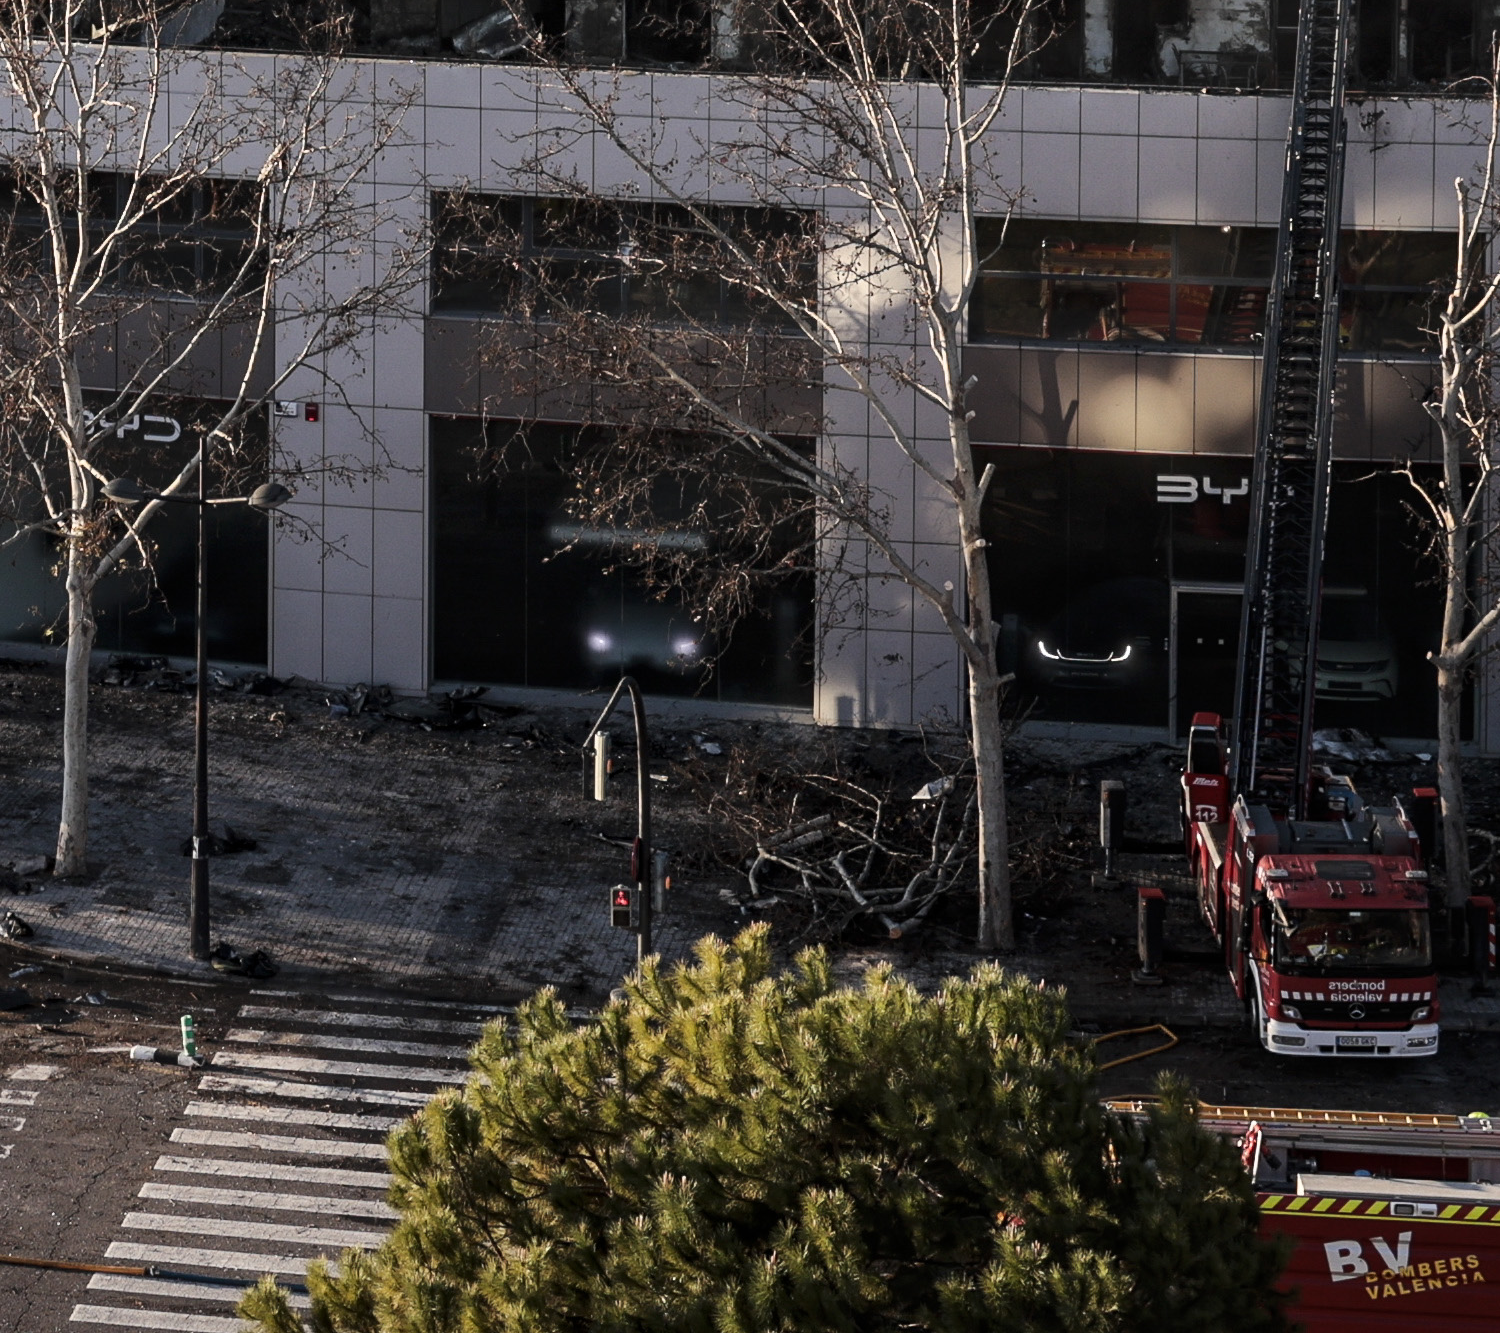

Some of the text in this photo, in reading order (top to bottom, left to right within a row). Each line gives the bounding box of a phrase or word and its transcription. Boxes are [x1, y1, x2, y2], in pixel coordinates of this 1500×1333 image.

[1157, 475, 1272, 505] BY
[1192, 777, 1219, 787] Metz
[1195, 811, 1219, 823] 112
[1323, 1231, 1413, 1283] BV
[1365, 1254, 1480, 1283] BOMBERS
[1365, 1271, 1487, 1300] VALENCIA
